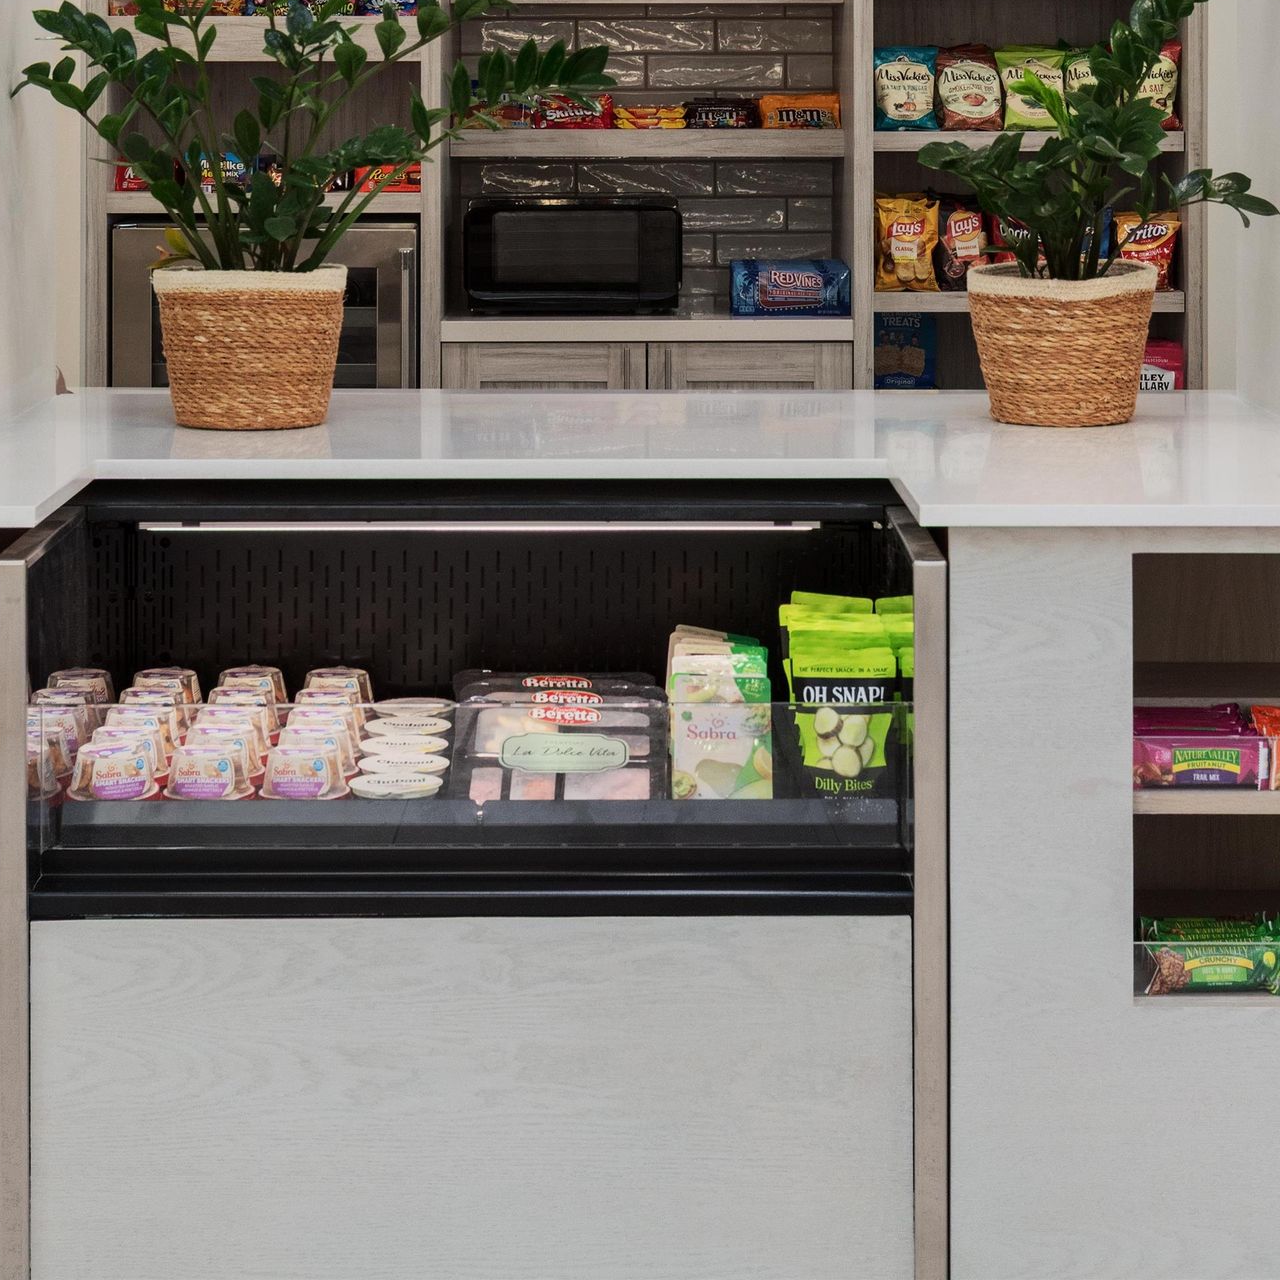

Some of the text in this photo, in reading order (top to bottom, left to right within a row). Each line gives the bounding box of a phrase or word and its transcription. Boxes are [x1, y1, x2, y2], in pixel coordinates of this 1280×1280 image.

[877, 68, 930, 84] Miss Vickie's
[943, 70, 997, 84] Miss Vickie's
[1068, 68, 1090, 81] Miss
[1149, 84, 1164, 93] SALT
[892, 221, 922, 237] Lay's
[951, 216, 980, 237] Lay's
[771, 270, 823, 288] RED VINES
[882, 316, 920, 328] TREATS
[526, 677, 589, 688] Beretta
[535, 692, 599, 704] Beretta
[803, 685, 885, 703] OH SNAP!
[532, 708, 599, 722] Beretta
[687, 724, 737, 739] Sabra
[513, 745, 618, 758] La Dolce Vita
[1175, 750, 1238, 764] NATURE VALLEY
[96, 770, 121, 779] Sabra
[178, 768, 201, 776] Sabra
[273, 767, 296, 776] Sabra
[1193, 773, 1220, 781] TRAIL MIX
[815, 776, 873, 795] Dilly Bites
[1185, 945, 1249, 959] NATURE VALLEY
